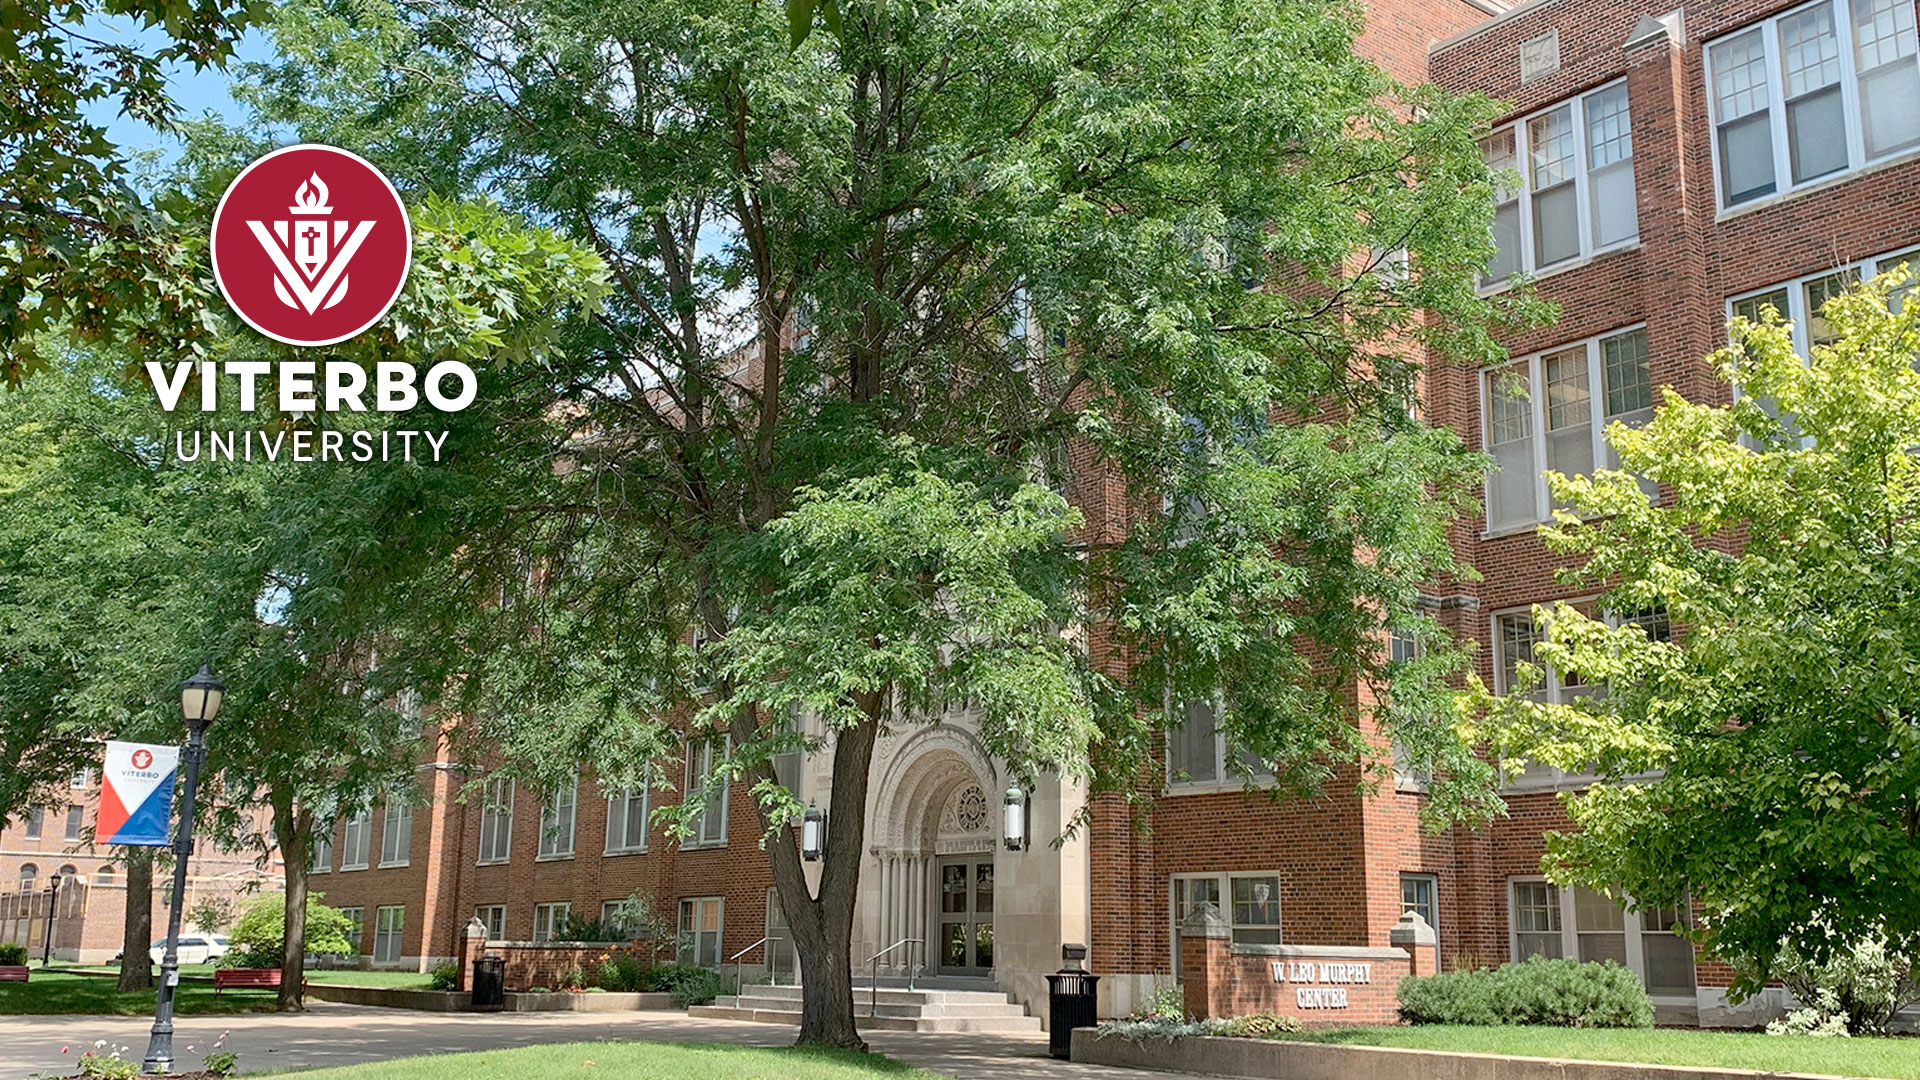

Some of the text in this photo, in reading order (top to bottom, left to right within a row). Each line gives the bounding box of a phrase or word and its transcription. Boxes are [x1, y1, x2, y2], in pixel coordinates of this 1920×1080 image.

[121, 770, 159, 778] VITERBO
[1289, 962, 1315, 982] LEO
[1319, 963, 1371, 983] MURPHY
[1297, 987, 1348, 1008] CENTER
